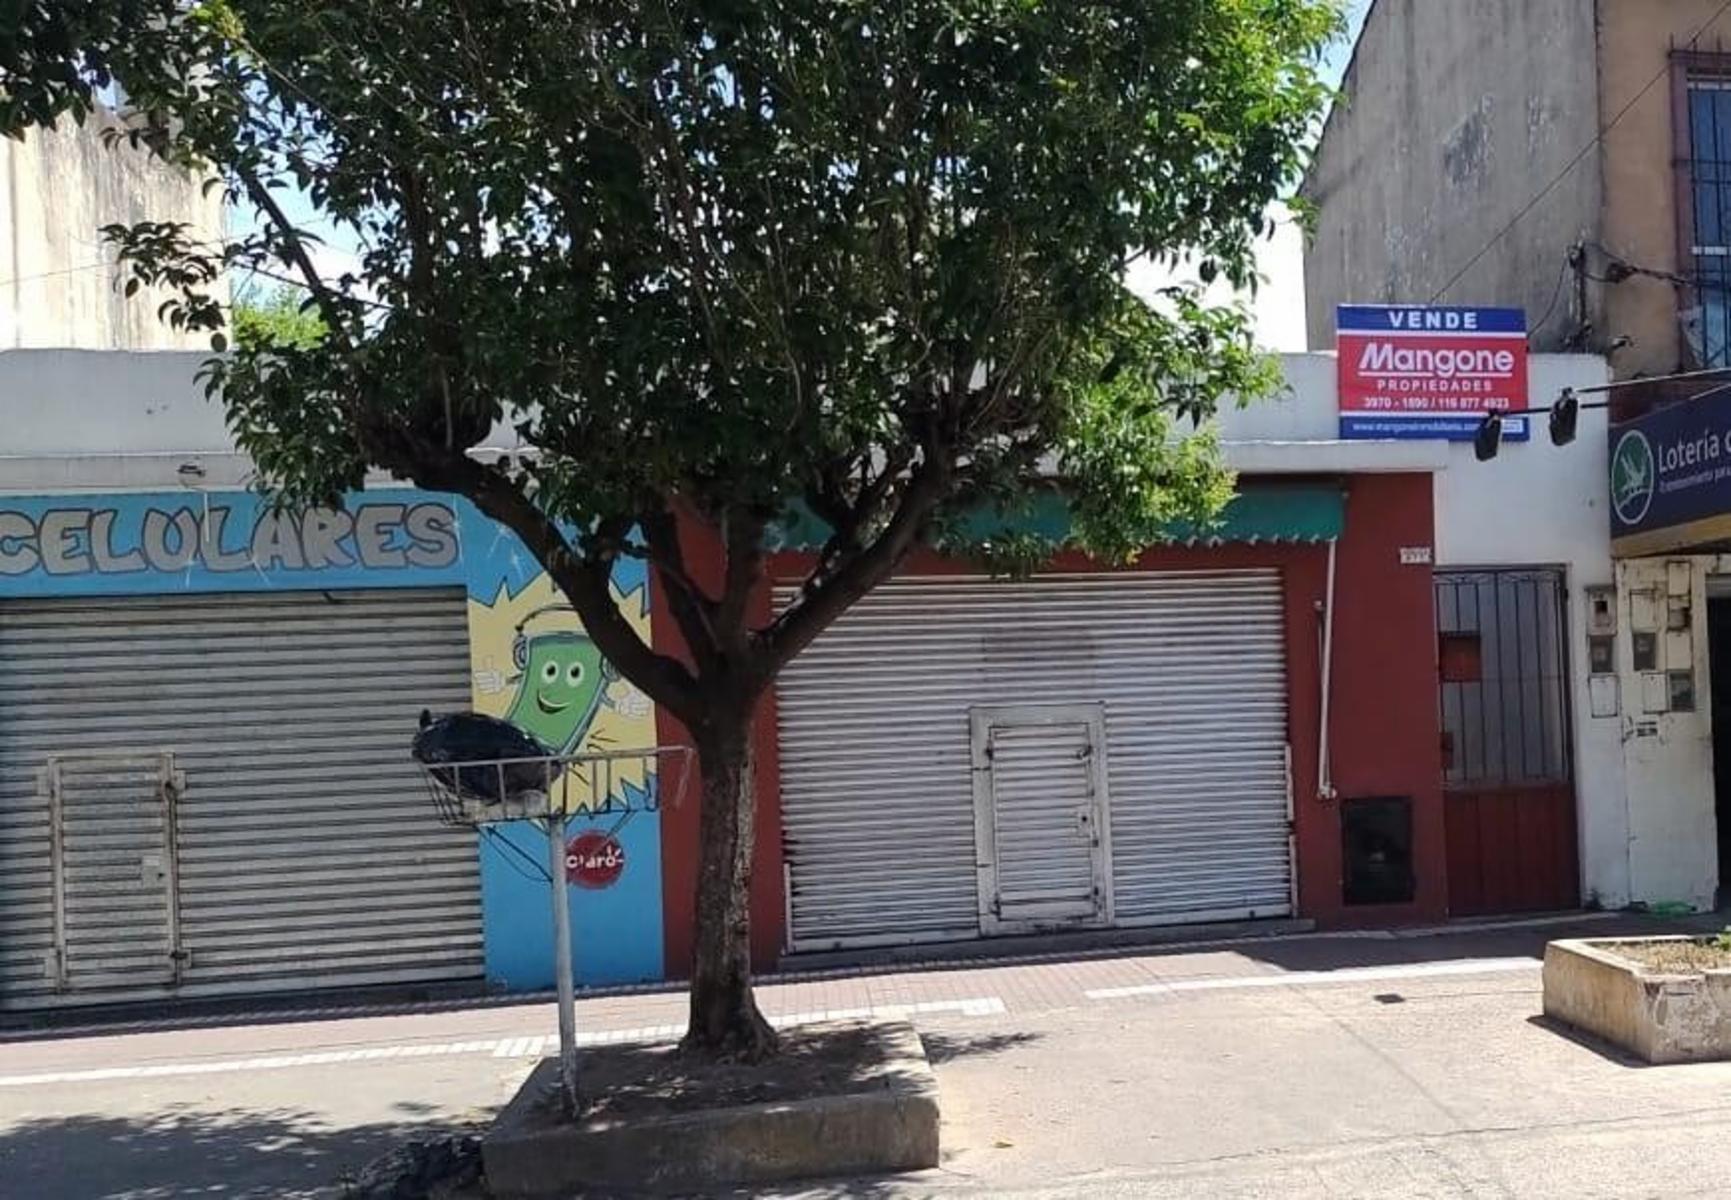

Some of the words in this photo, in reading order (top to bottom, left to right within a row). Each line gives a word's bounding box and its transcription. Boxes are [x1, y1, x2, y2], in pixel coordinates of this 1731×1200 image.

[1388, 311, 1478, 329] VENDE
[1358, 342, 1514, 378] Mangone
[1377, 379, 1492, 392] PROPIEDADES
[0, 503, 459, 575] CELULARES
